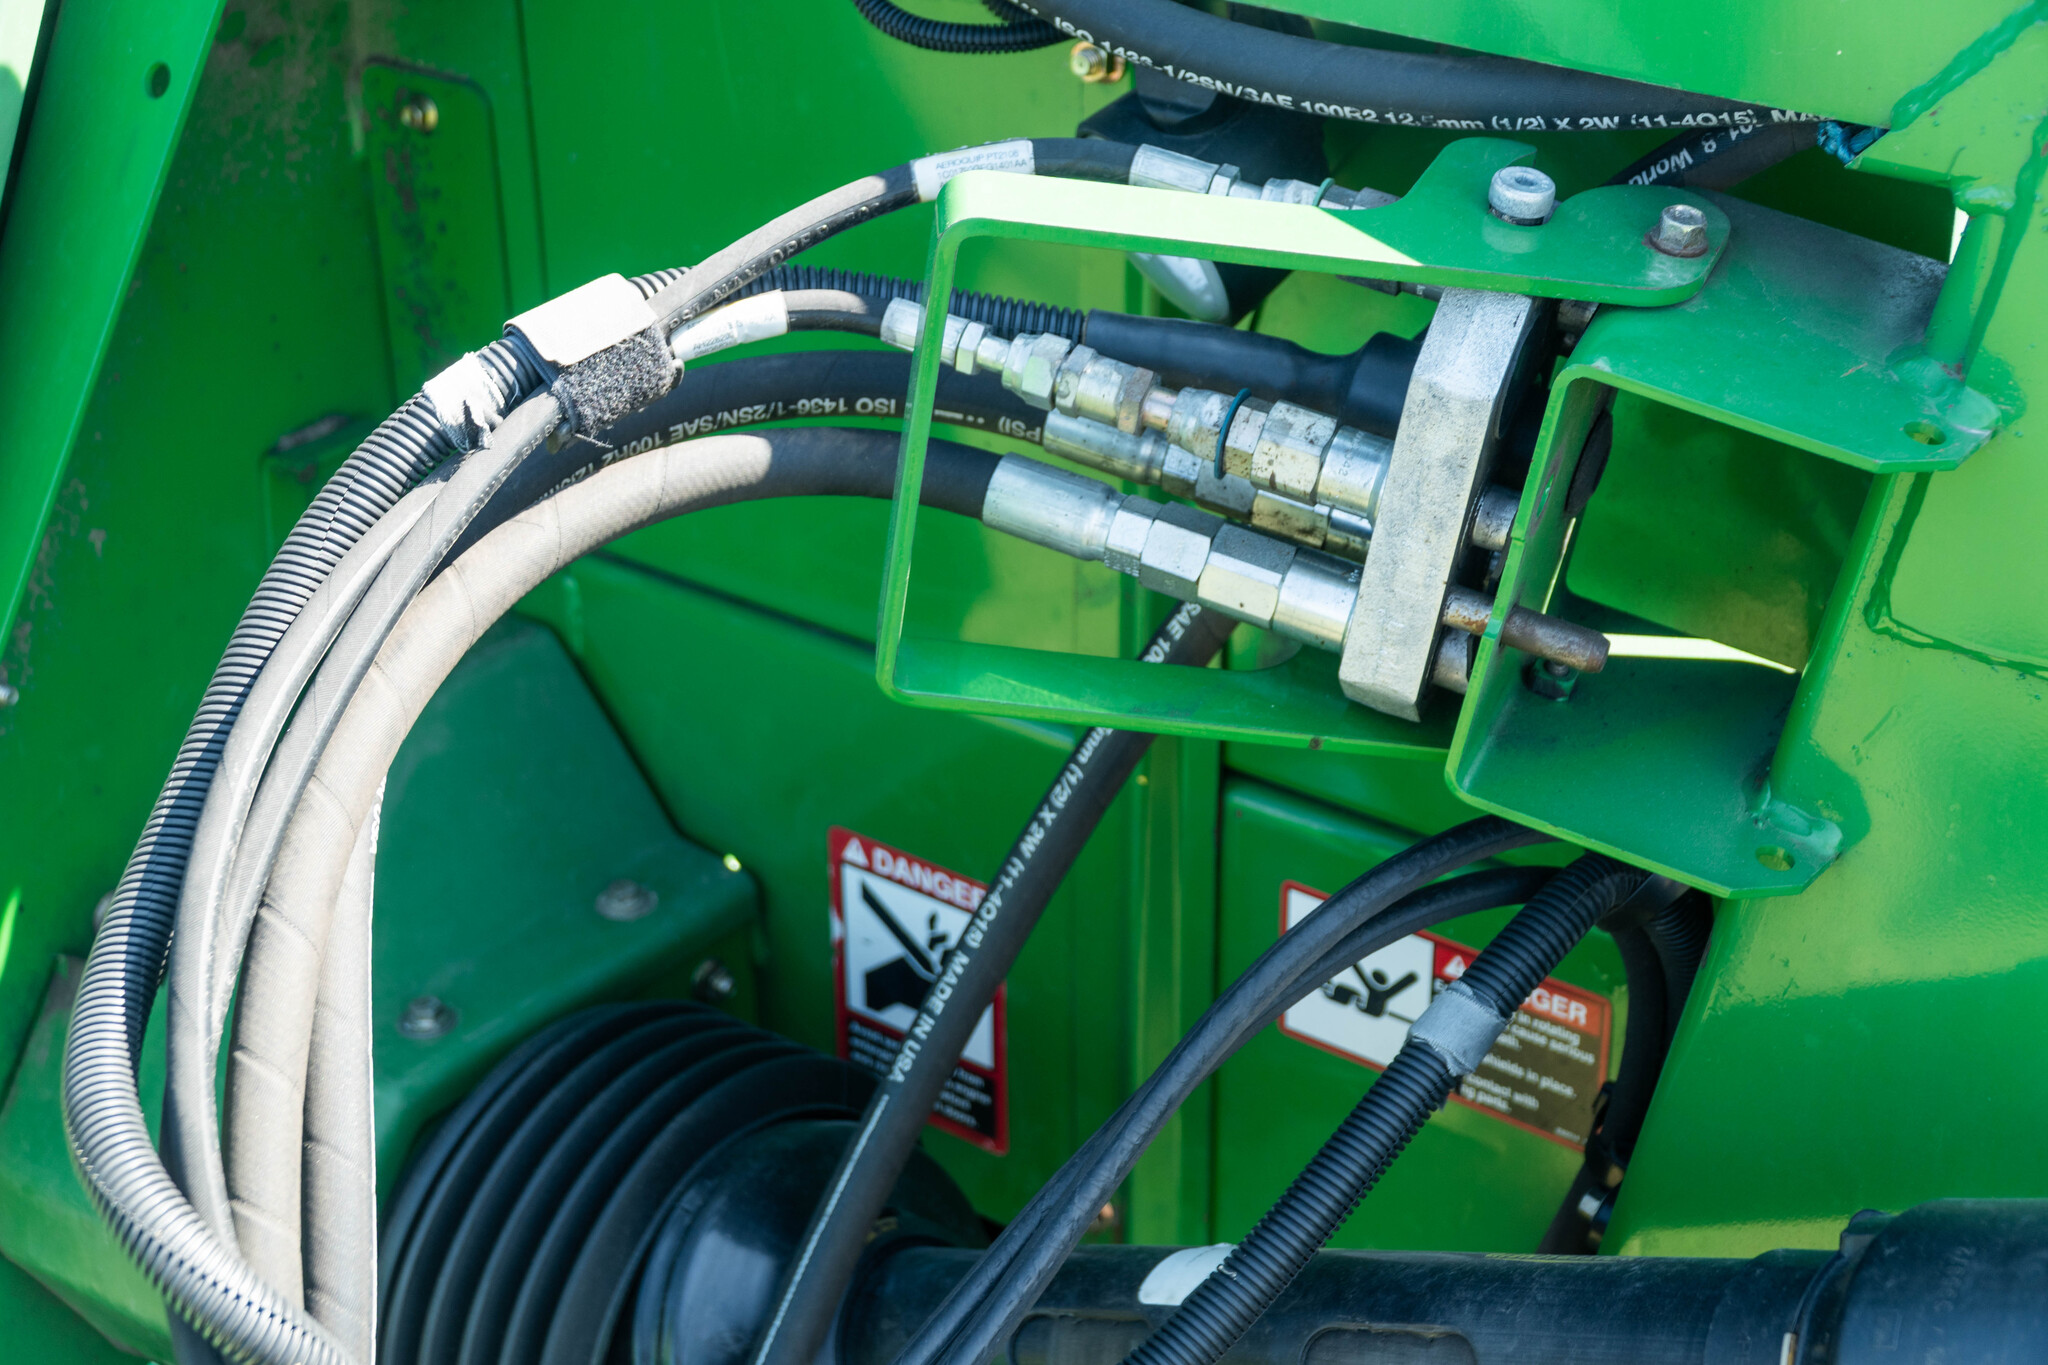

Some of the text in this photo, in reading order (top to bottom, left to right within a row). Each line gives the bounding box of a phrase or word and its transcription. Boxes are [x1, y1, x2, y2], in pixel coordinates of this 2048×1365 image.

[1552, 117, 1574, 130] X
[1578, 115, 1620, 130] 2W
[854, 397, 896, 416] ISO
[998, 416, 1042, 443] PSI)
[1038, 803, 1057, 828] X
[1019, 820, 1045, 859] 2W
[925, 949, 970, 1016] MADE
[912, 1012, 936, 1040] IN
[887, 1039, 922, 1083] USA
